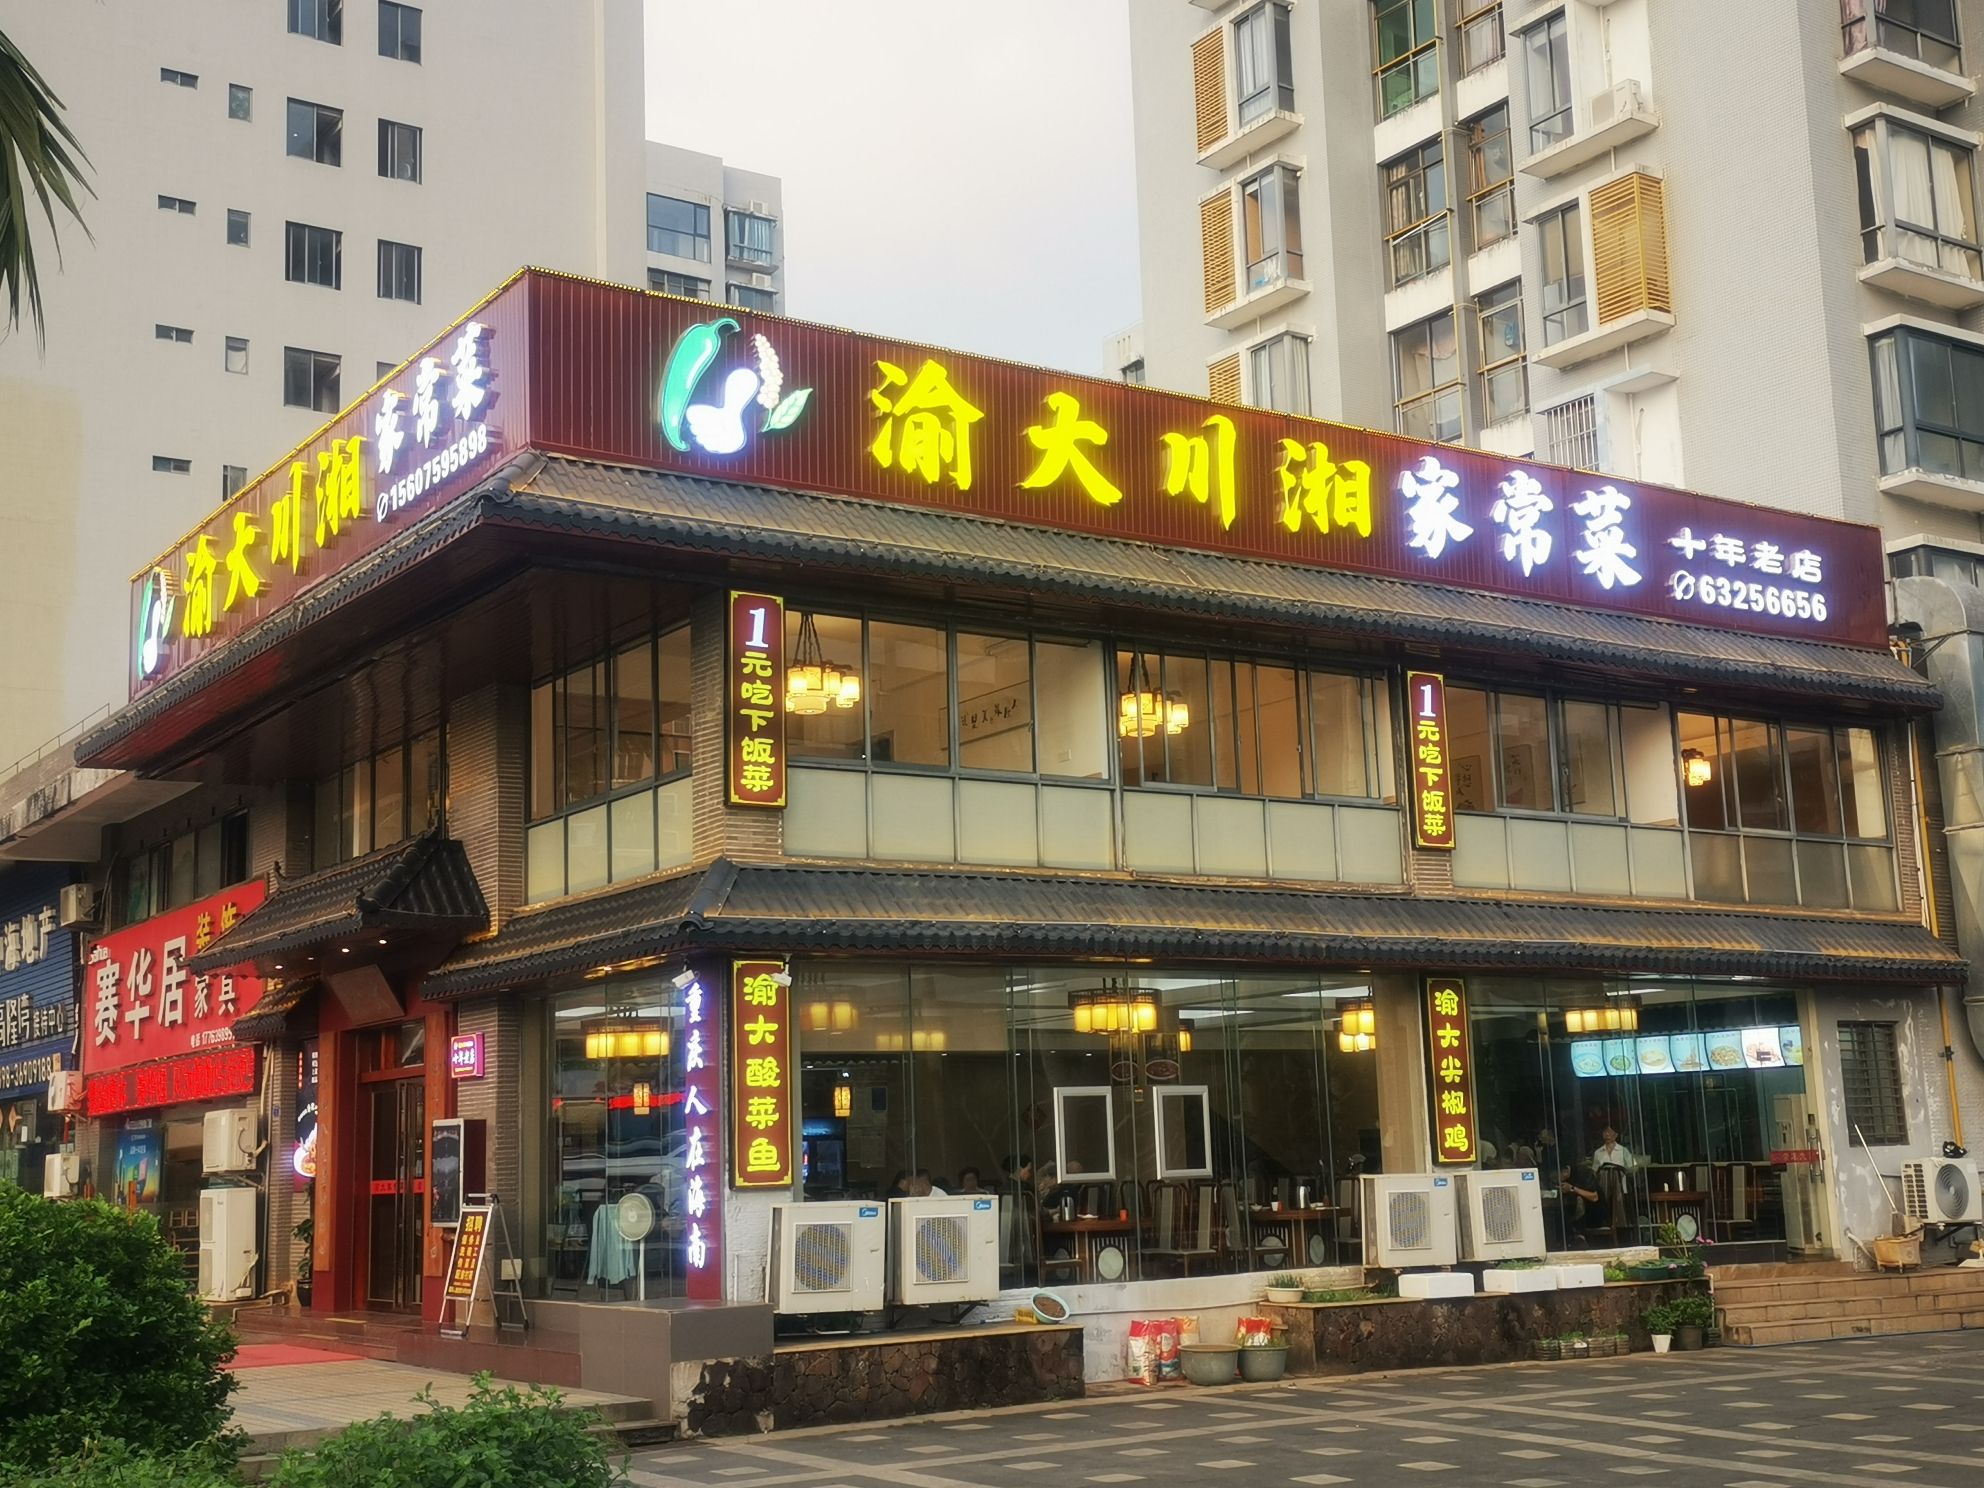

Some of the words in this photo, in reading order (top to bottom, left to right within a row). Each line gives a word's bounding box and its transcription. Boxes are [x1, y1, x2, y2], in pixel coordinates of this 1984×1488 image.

[183, 435, 367, 637] 渝大川湘
[375, 321, 488, 474] 家常菜
[390, 423, 487, 510] 15607595898
[869, 358, 1372, 538] 渝大川湘
[1399, 455, 1643, 590] 家常菜
[1670, 527, 1823, 583] 十年老店
[1699, 573, 1828, 622] 63256656
[740, 607, 775, 792] 1元吃下饭菜
[1416, 684, 1446, 836] 1元吃下饭菜
[0, 1056, 51, 1089] 98-36909188
[743, 973, 781, 1172] 渝大酸菜鱼
[1434, 988, 1469, 1152] 渝大尖椒鸡
